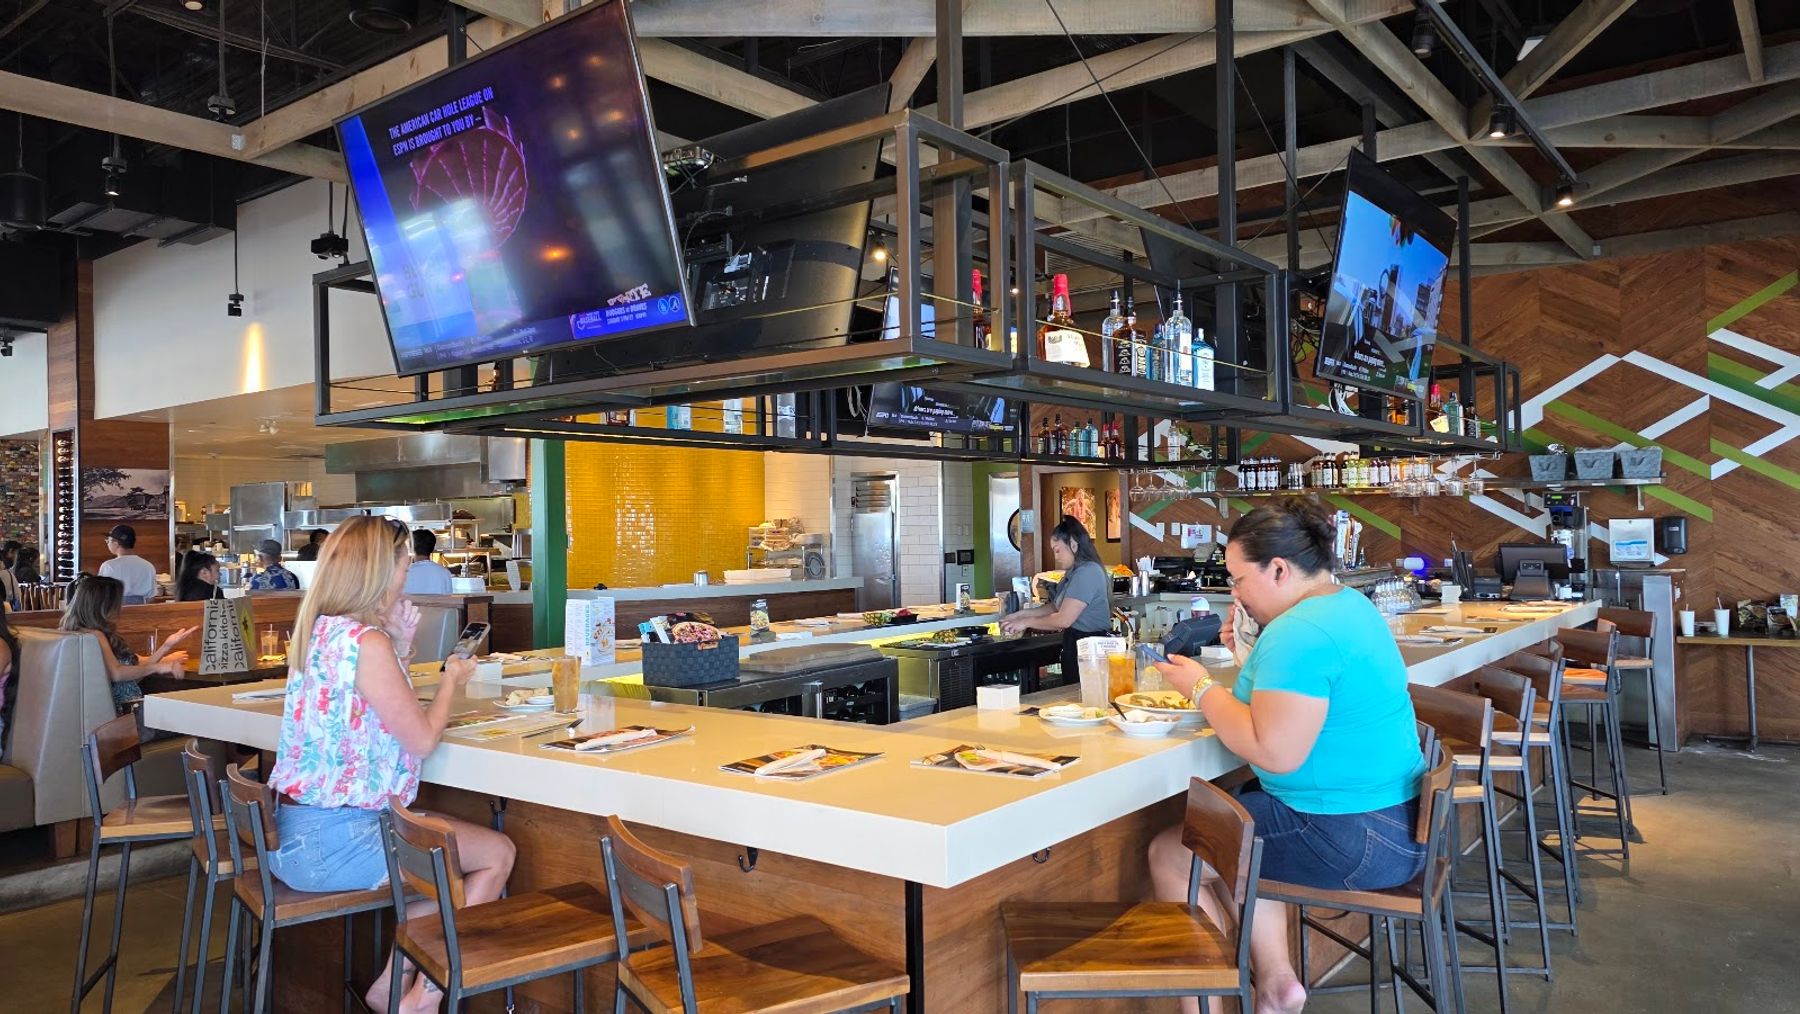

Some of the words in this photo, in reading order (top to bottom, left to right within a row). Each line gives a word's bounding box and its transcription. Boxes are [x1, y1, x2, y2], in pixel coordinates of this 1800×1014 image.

[389, 125, 401, 139] THE
[400, 113, 430, 135] AMERICAN
[429, 108, 443, 122] CAR
[458, 90, 484, 111] LEAGUE
[483, 86, 494, 101] ON
[393, 141, 409, 156] ESPN
[408, 137, 416, 150] IS
[415, 126, 443, 148] BROUGHT
[442, 123, 452, 136] TO
[451, 117, 465, 133] YOU
[464, 114, 474, 128] BY
